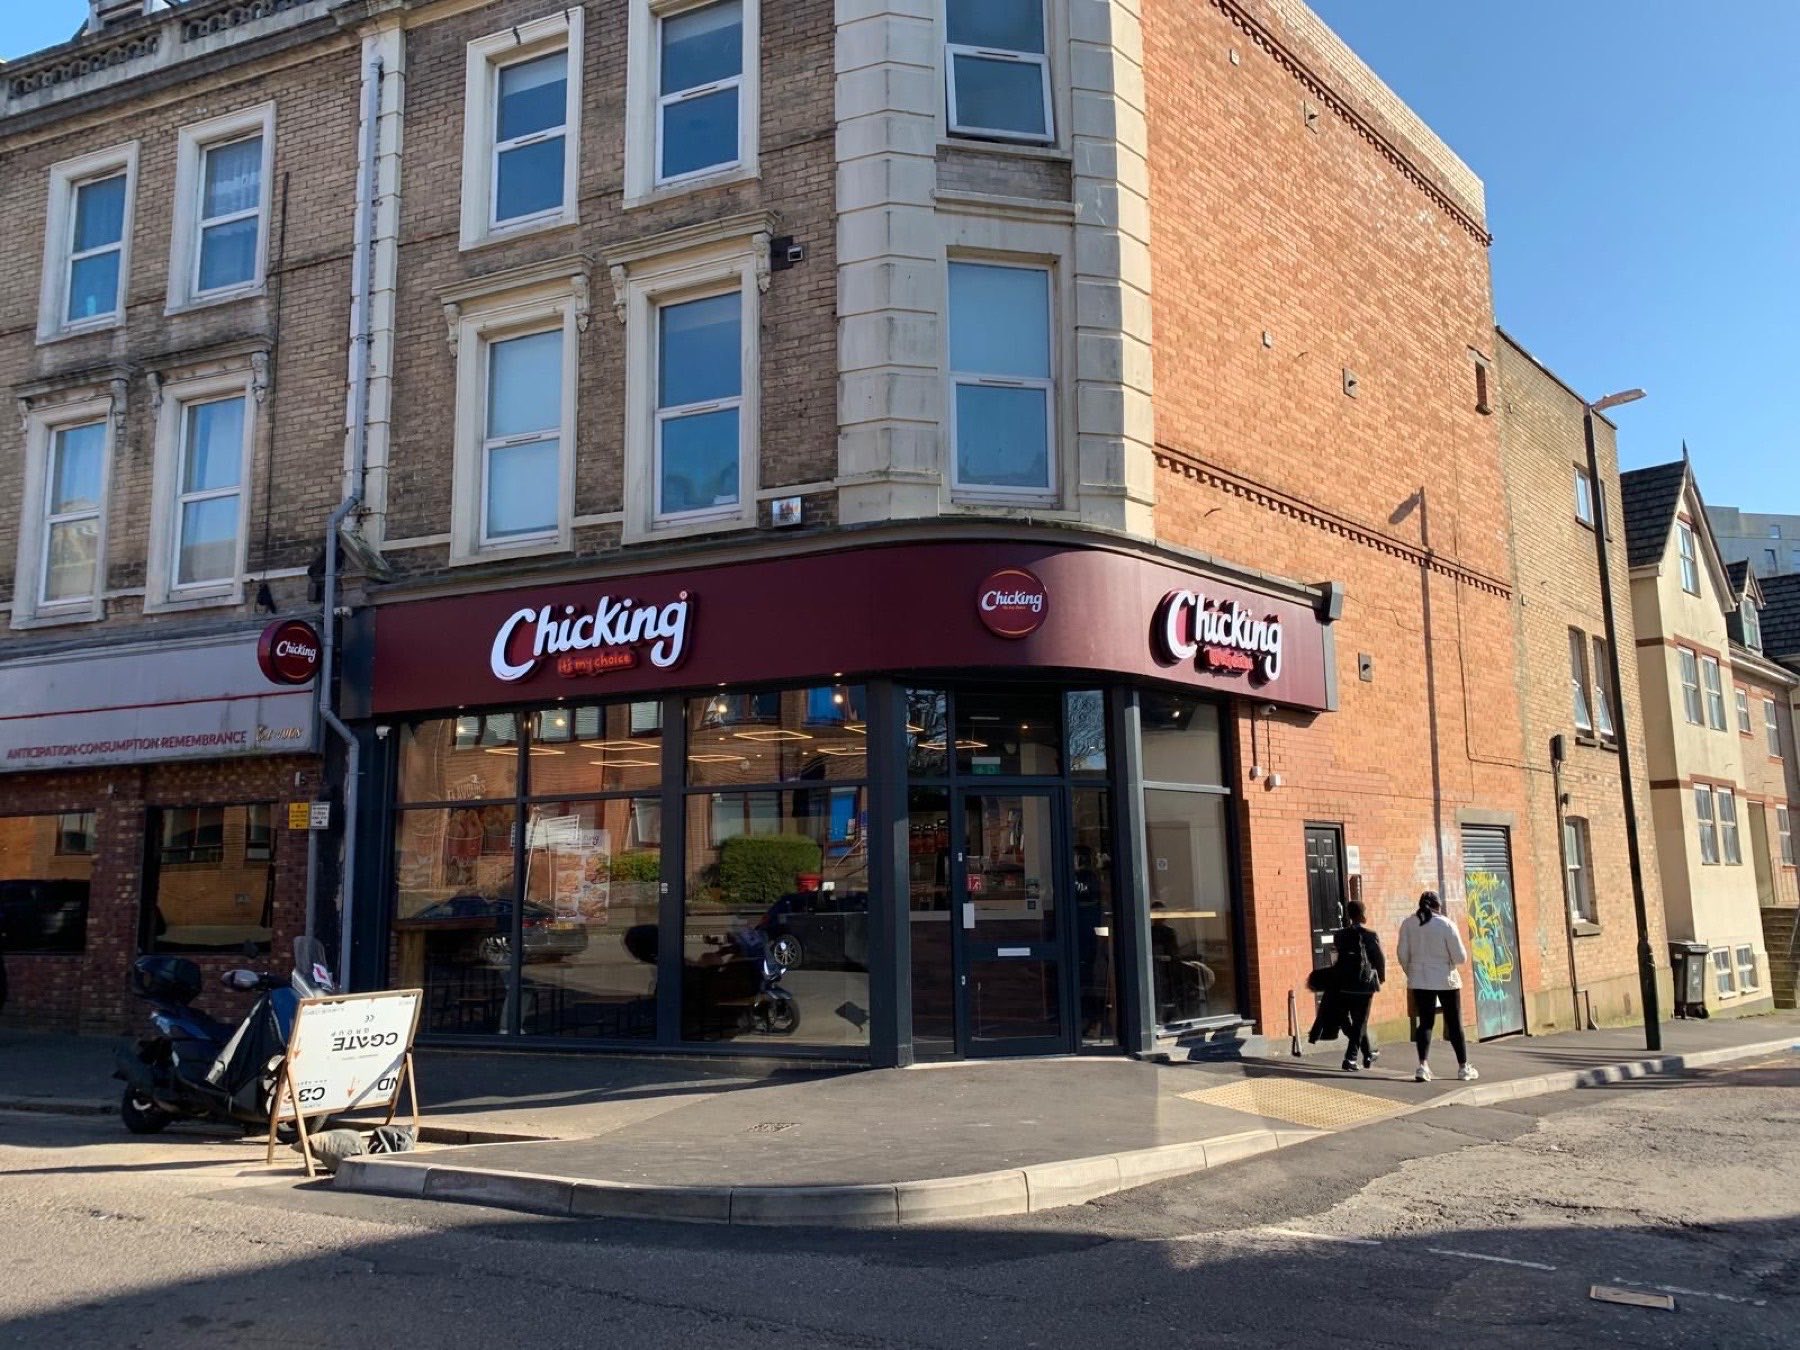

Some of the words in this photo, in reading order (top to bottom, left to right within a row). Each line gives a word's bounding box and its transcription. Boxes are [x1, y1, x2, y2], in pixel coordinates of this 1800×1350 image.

[981, 590, 1043, 612] Chicking
[490, 589, 689, 681] Chicking
[1167, 590, 1282, 681] Chicking
[276, 640, 317, 663] Chicking
[594, 652, 631, 668] choice
[332, 1032, 399, 1052] CGATE
